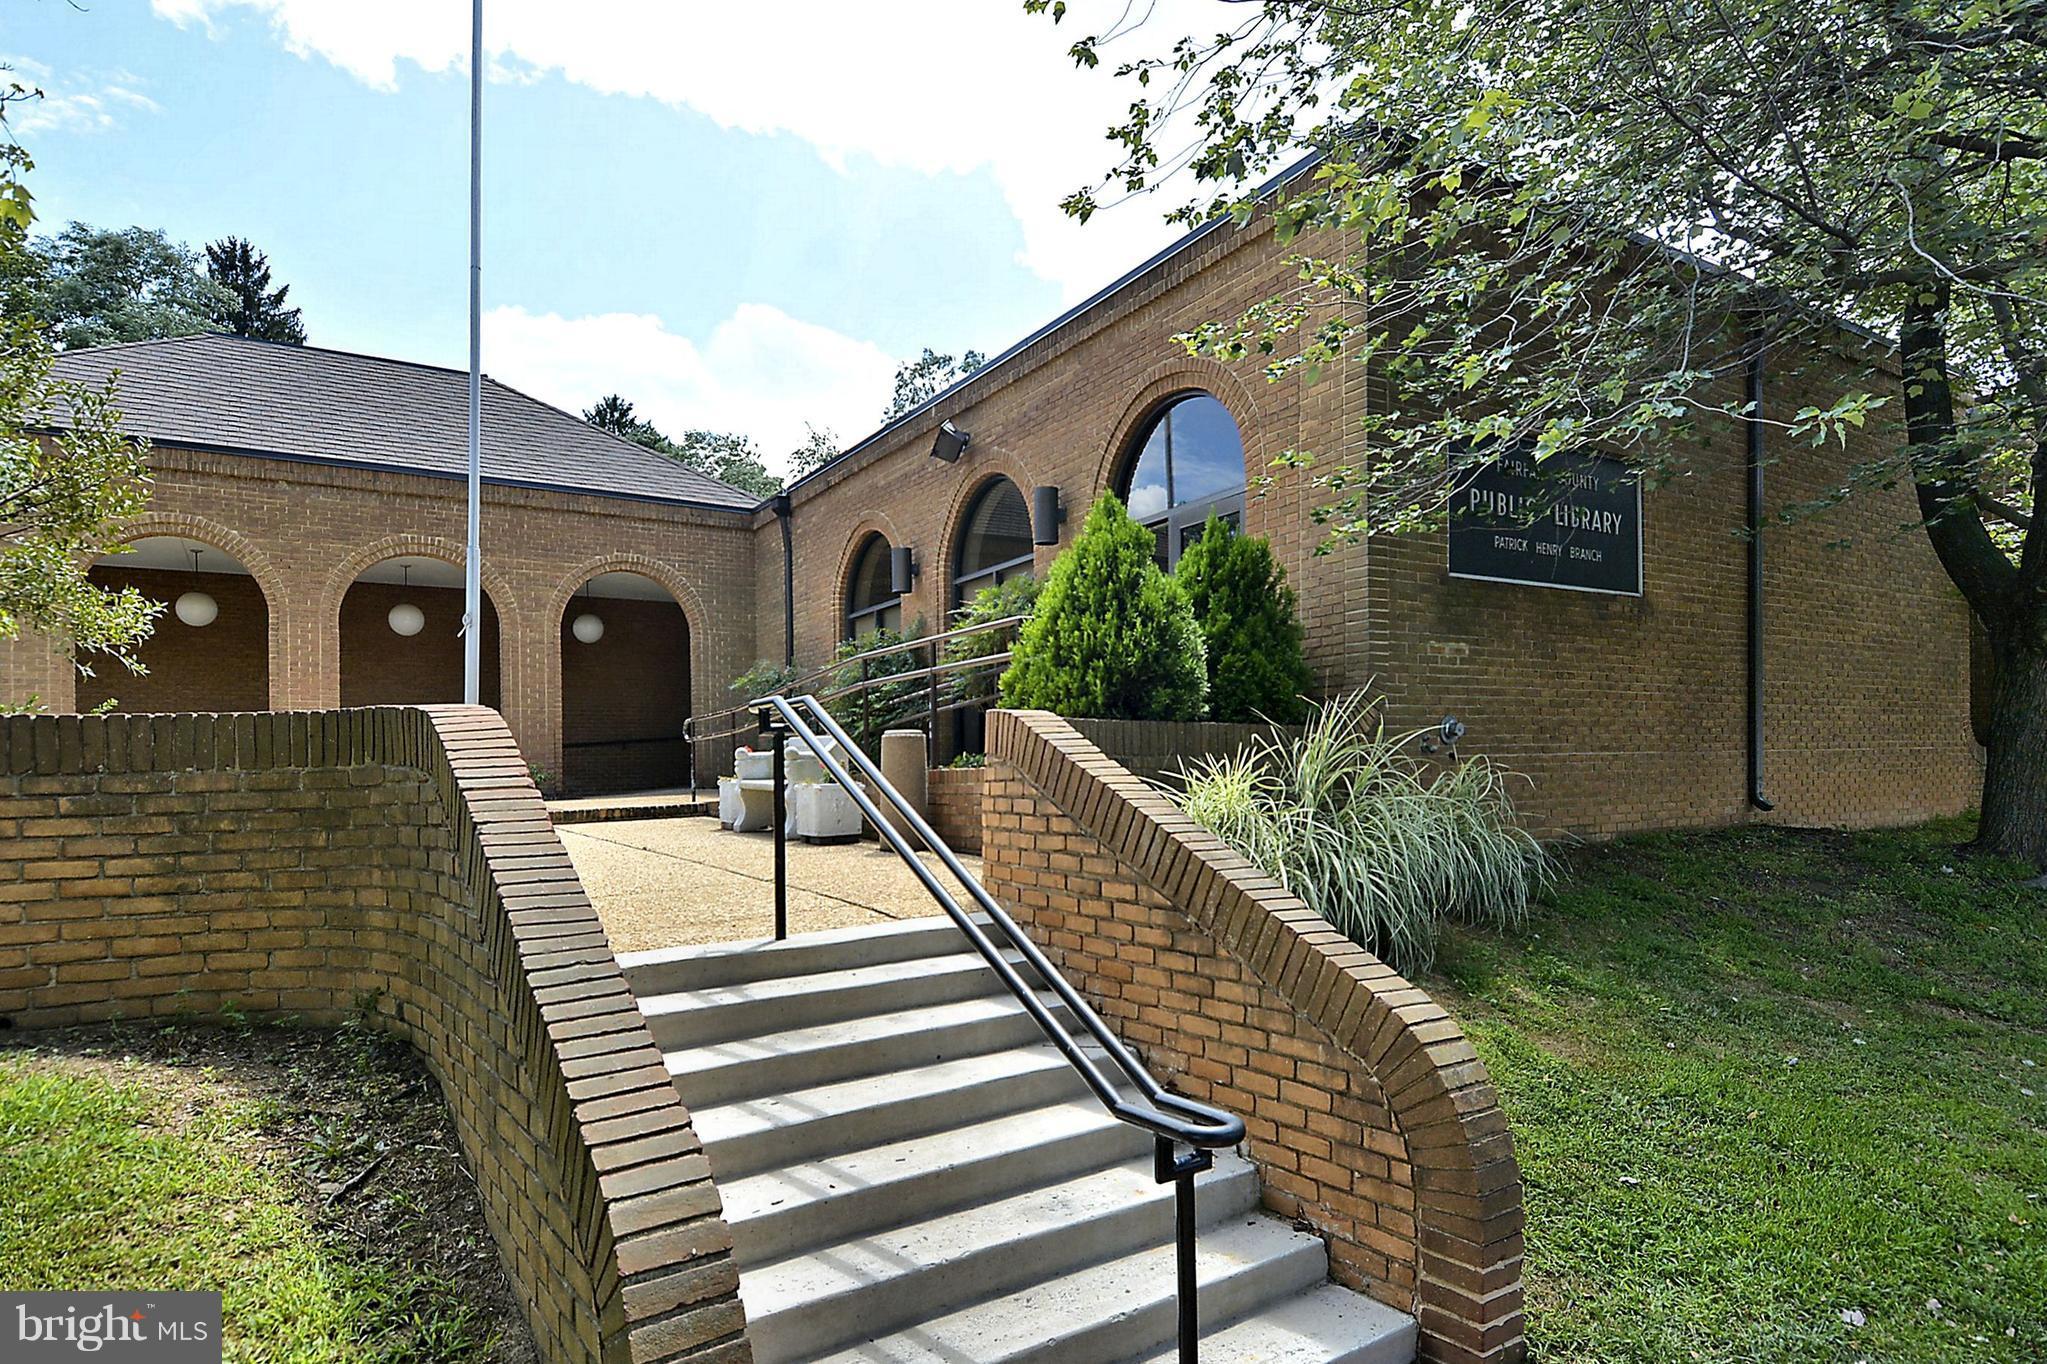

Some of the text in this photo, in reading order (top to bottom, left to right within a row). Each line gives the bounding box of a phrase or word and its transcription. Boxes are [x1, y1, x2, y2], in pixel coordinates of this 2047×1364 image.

[1554, 503, 1623, 536] LIBRARY
[1494, 535, 1602, 562] PATRICK HENRY BRANCH
